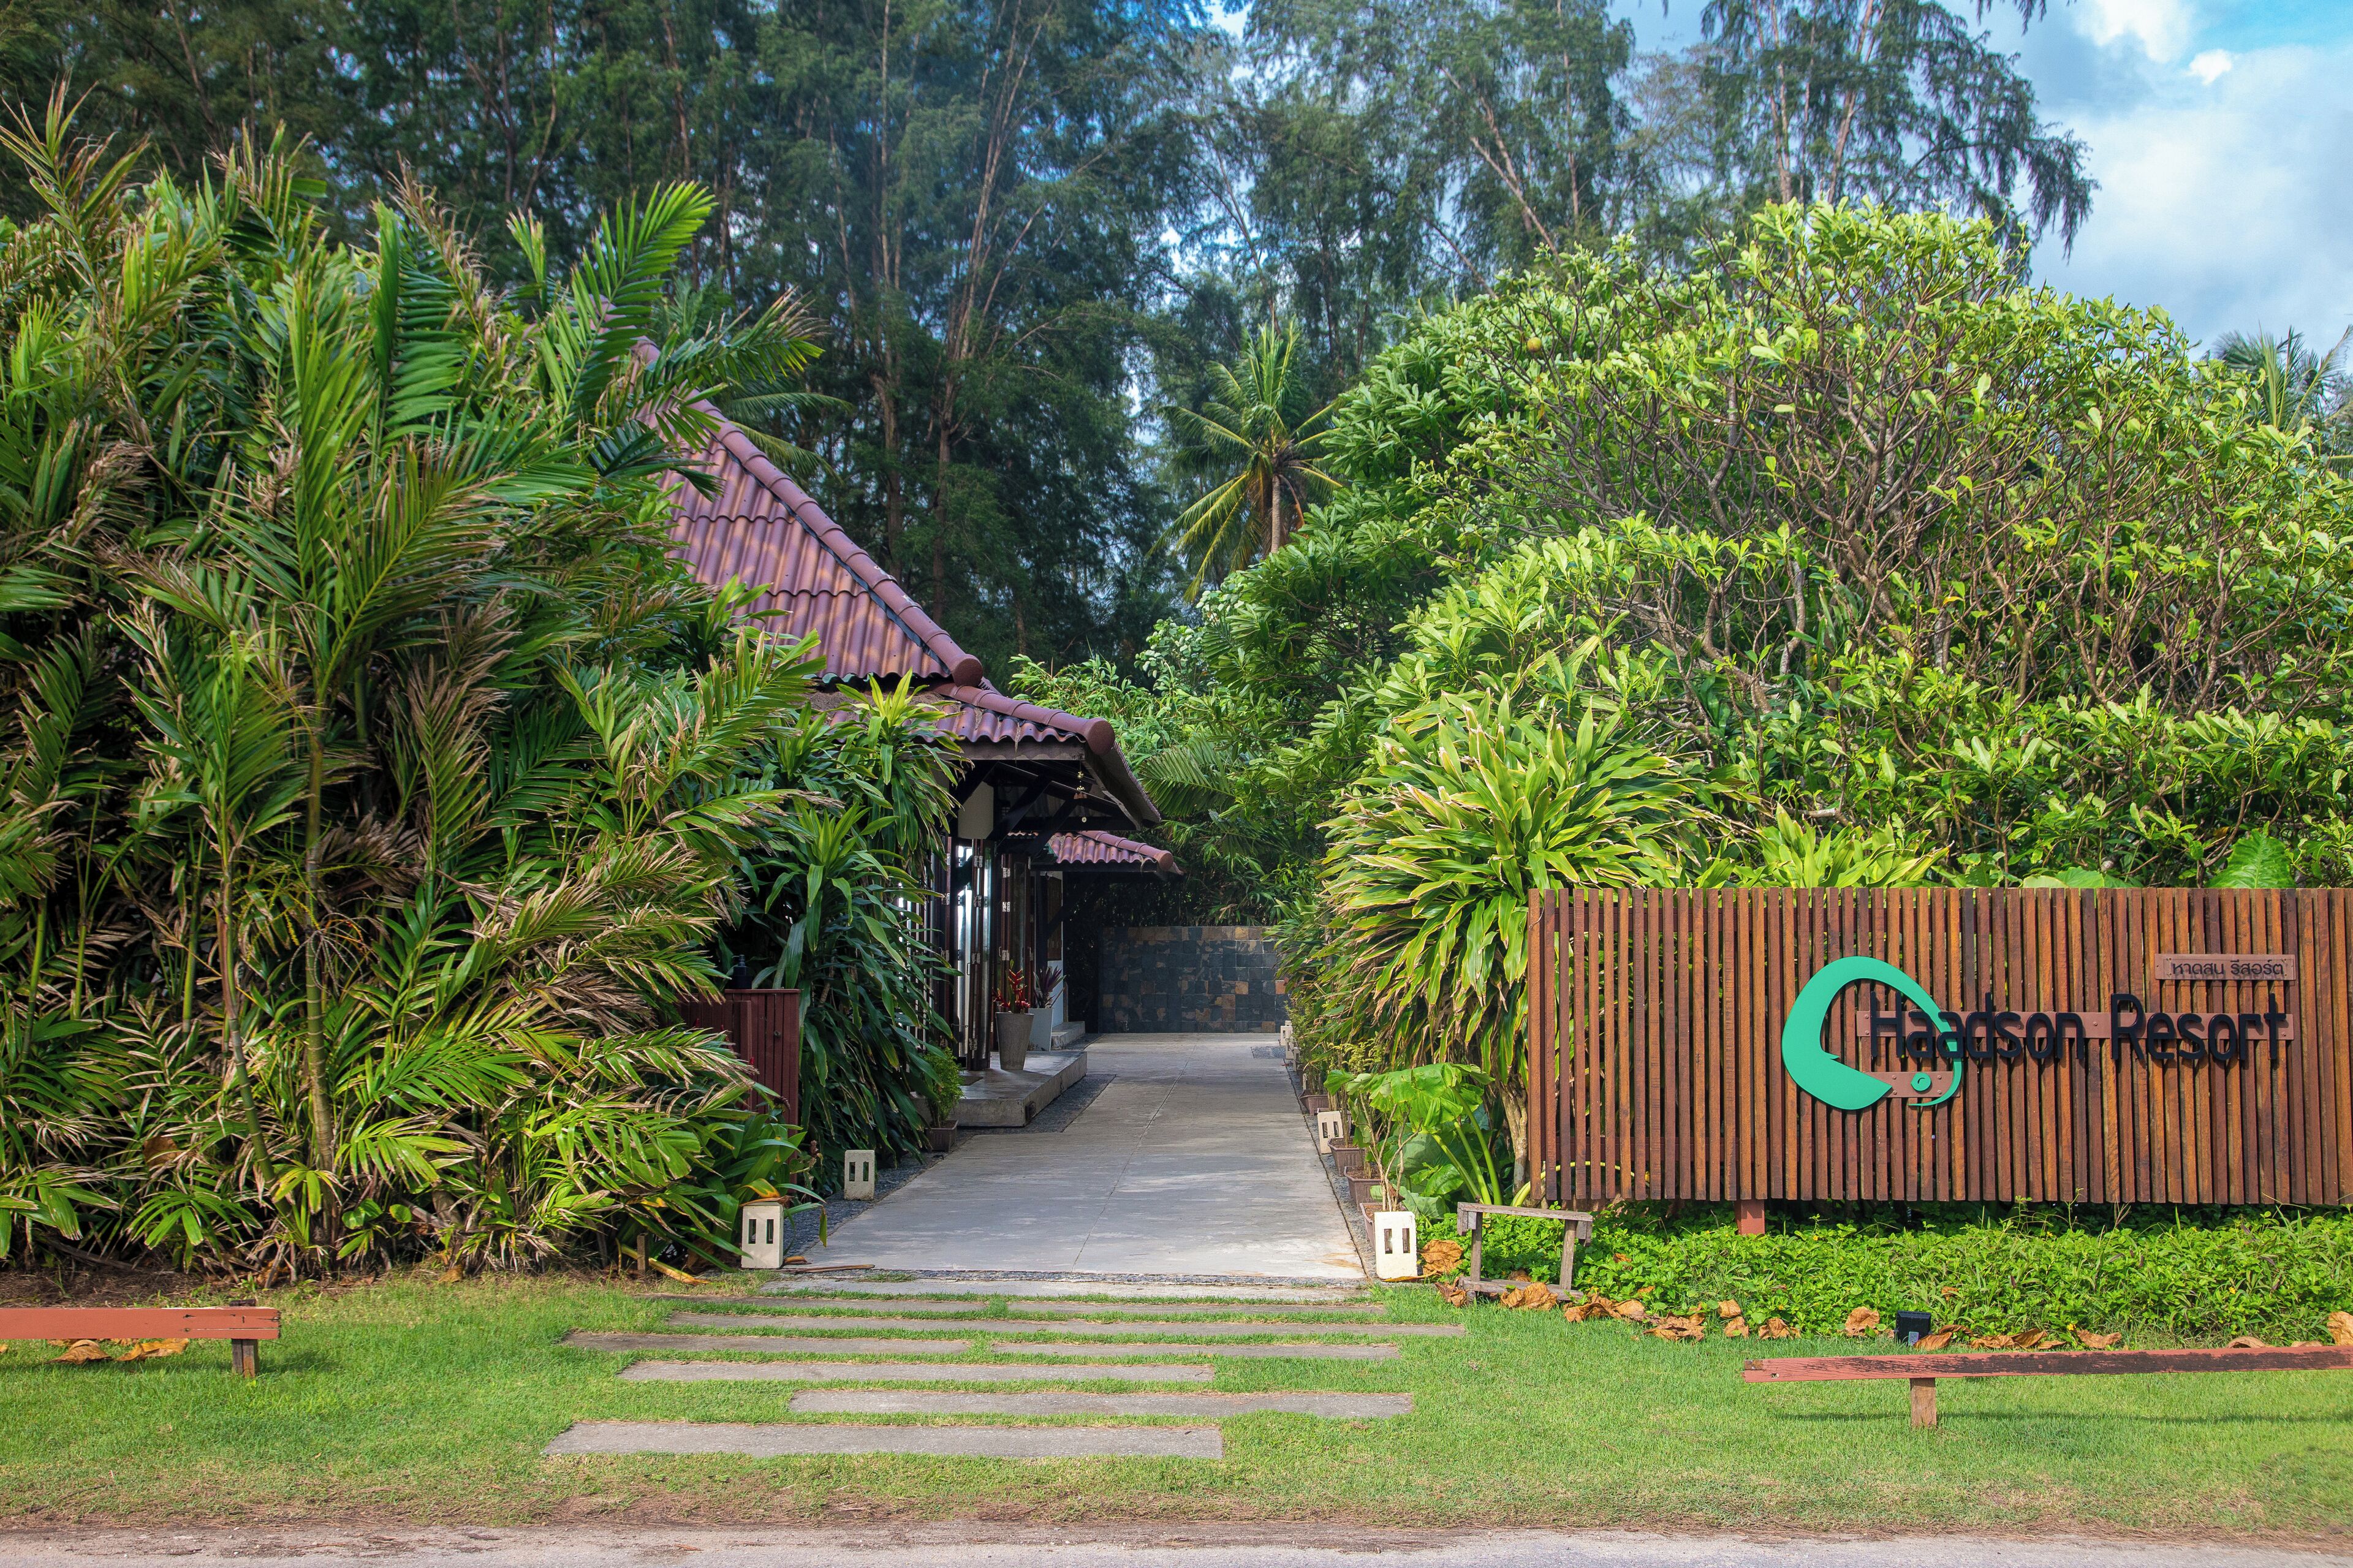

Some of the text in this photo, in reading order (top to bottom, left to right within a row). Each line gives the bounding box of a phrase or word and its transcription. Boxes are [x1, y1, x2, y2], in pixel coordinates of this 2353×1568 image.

[2172, 960, 2284, 975] หาดสน รีสอร์ต
[1871, 991, 2287, 1061] Haadson Resort
